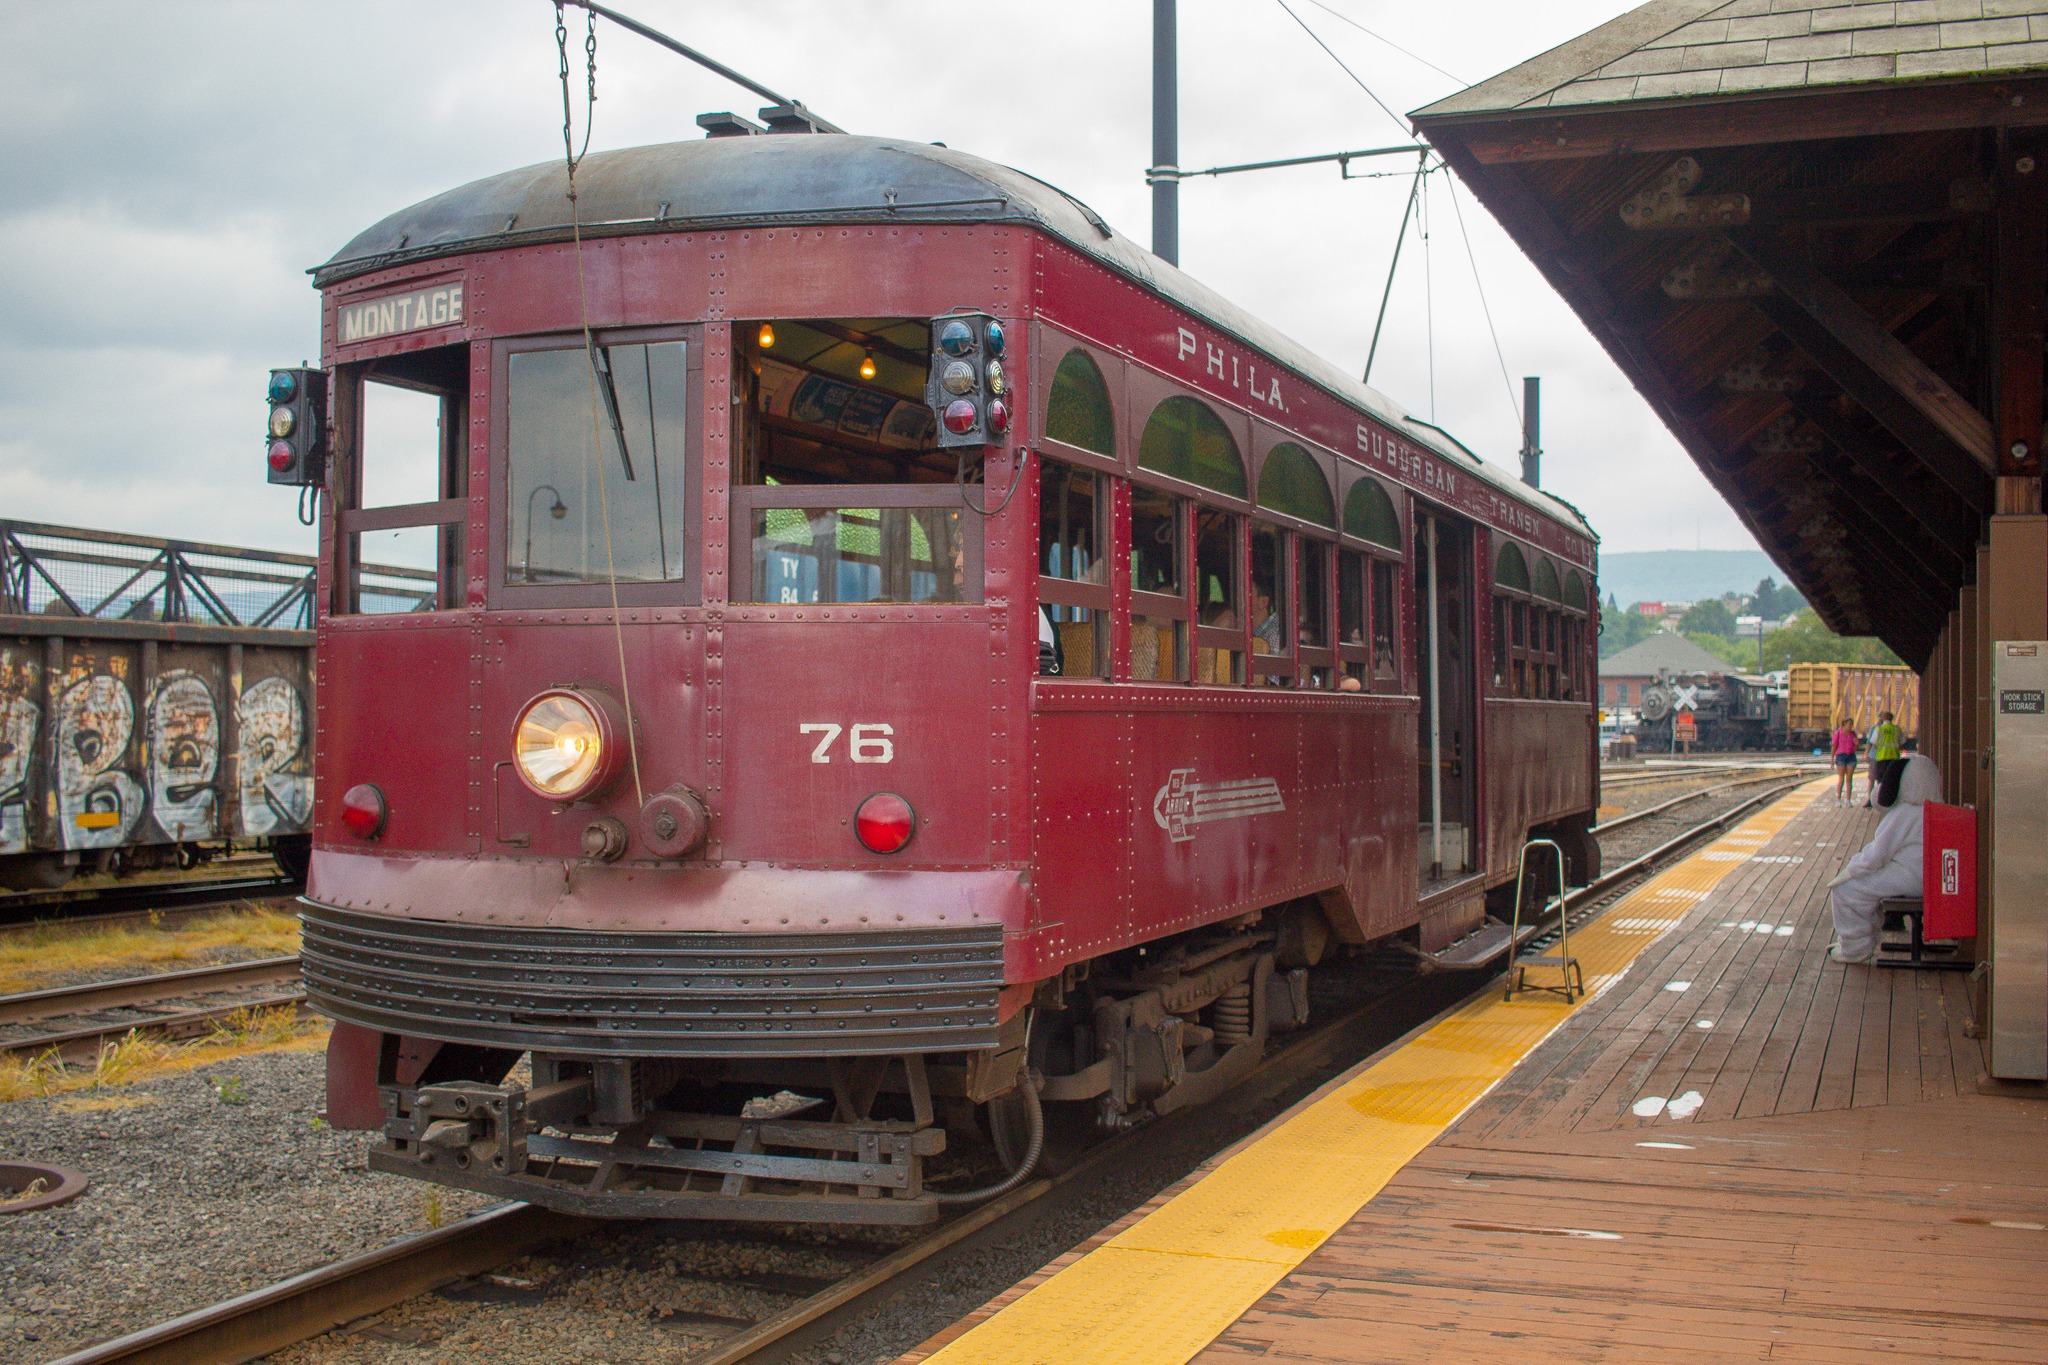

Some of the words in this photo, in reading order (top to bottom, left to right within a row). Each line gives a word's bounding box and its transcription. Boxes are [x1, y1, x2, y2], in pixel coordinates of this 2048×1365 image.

[345, 287, 463, 342] MONTAGE
[1177, 327, 1289, 413] PHILA.
[1356, 424, 1455, 495] SUBURBAN
[780, 557, 799, 579] TY
[2003, 693, 2020, 701] HOOK
[2023, 693, 2041, 701] STICK
[2008, 702, 2037, 711] STORAGE
[800, 723, 894, 764] 76
